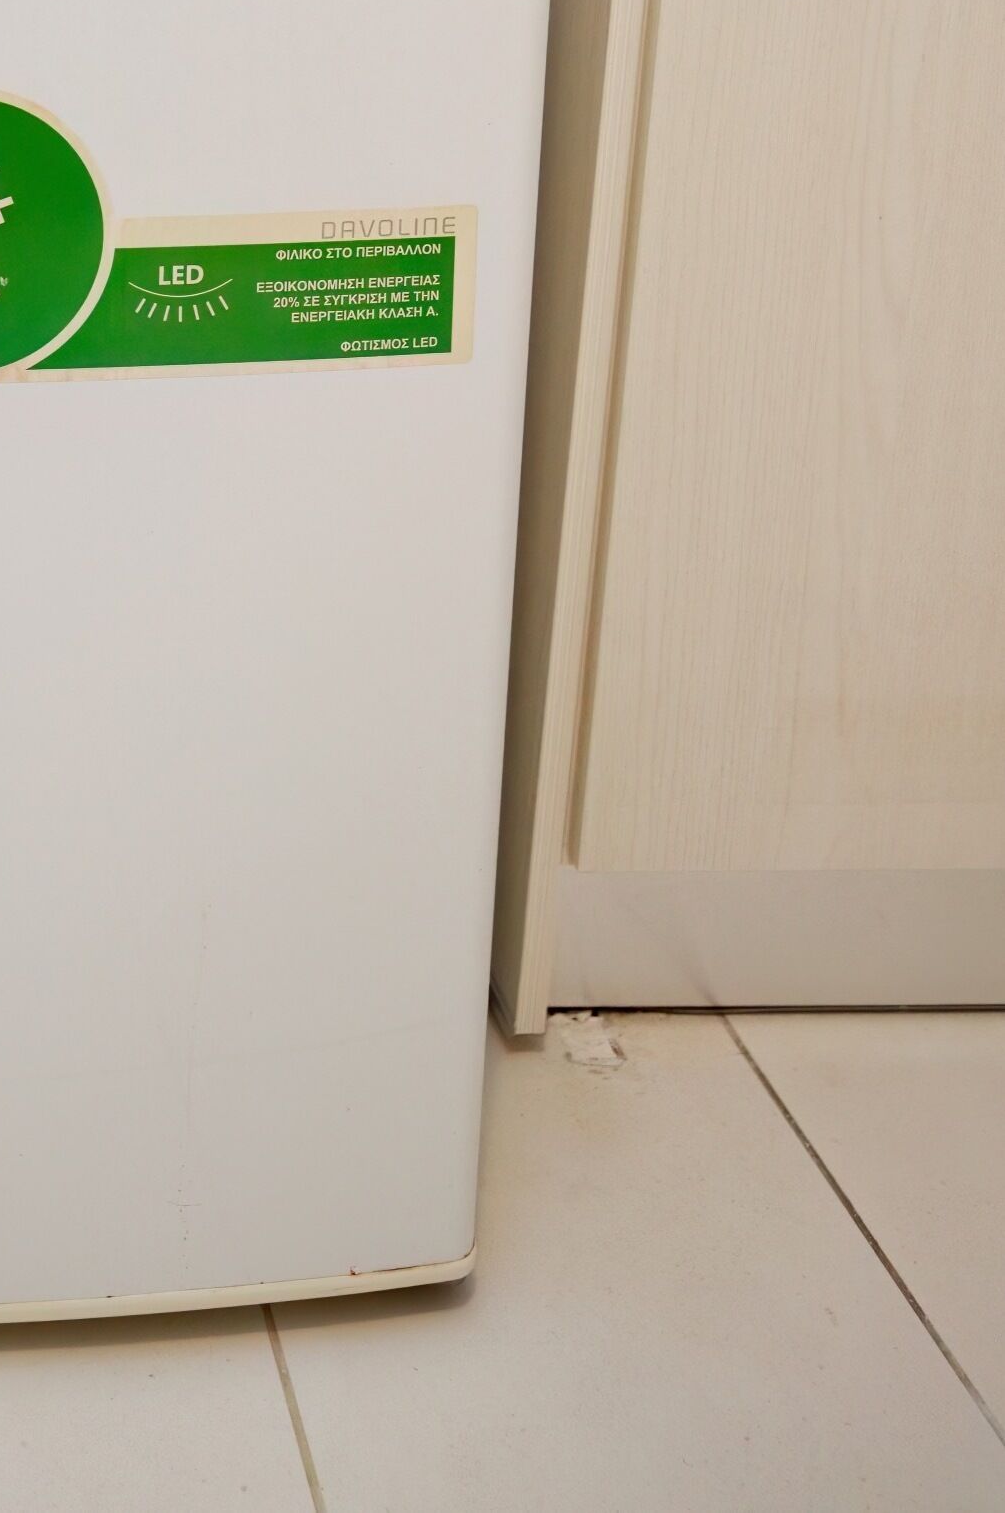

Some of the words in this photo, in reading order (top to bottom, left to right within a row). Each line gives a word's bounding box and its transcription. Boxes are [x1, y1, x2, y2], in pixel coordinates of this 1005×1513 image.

[321, 216, 457, 240] DAVOLINE
[275, 248, 323, 261] ΦΙΛΙΚΟ
[325, 247, 353, 259] ΣΤΟ
[356, 243, 442, 258] ΠΕΡΙΒΑΛΛΟΝ
[157, 264, 205, 286] LED
[256, 278, 365, 293] ΕΞΟΙΚΟΝΟΜΗΣΗ
[368, 274, 441, 289] ΕΝΕΡΓΕΙΑΣ
[273, 296, 300, 308] 20%
[303, 295, 320, 307] ΣΕ
[323, 292, 387, 306] ΣΥΓΚΡΙΣΗ
[390, 291, 410, 303] ΜΕ
[413, 290, 440, 302] ΤΗΝ
[291, 309, 376, 323] ΕΝΕΡΓΕΙΑΚΗ
[378, 306, 423, 319] ΚΛΑΣΗ
[340, 338, 410, 353] ΦΩΤΙΣΜΟΣ
[412, 336, 439, 349] LED
